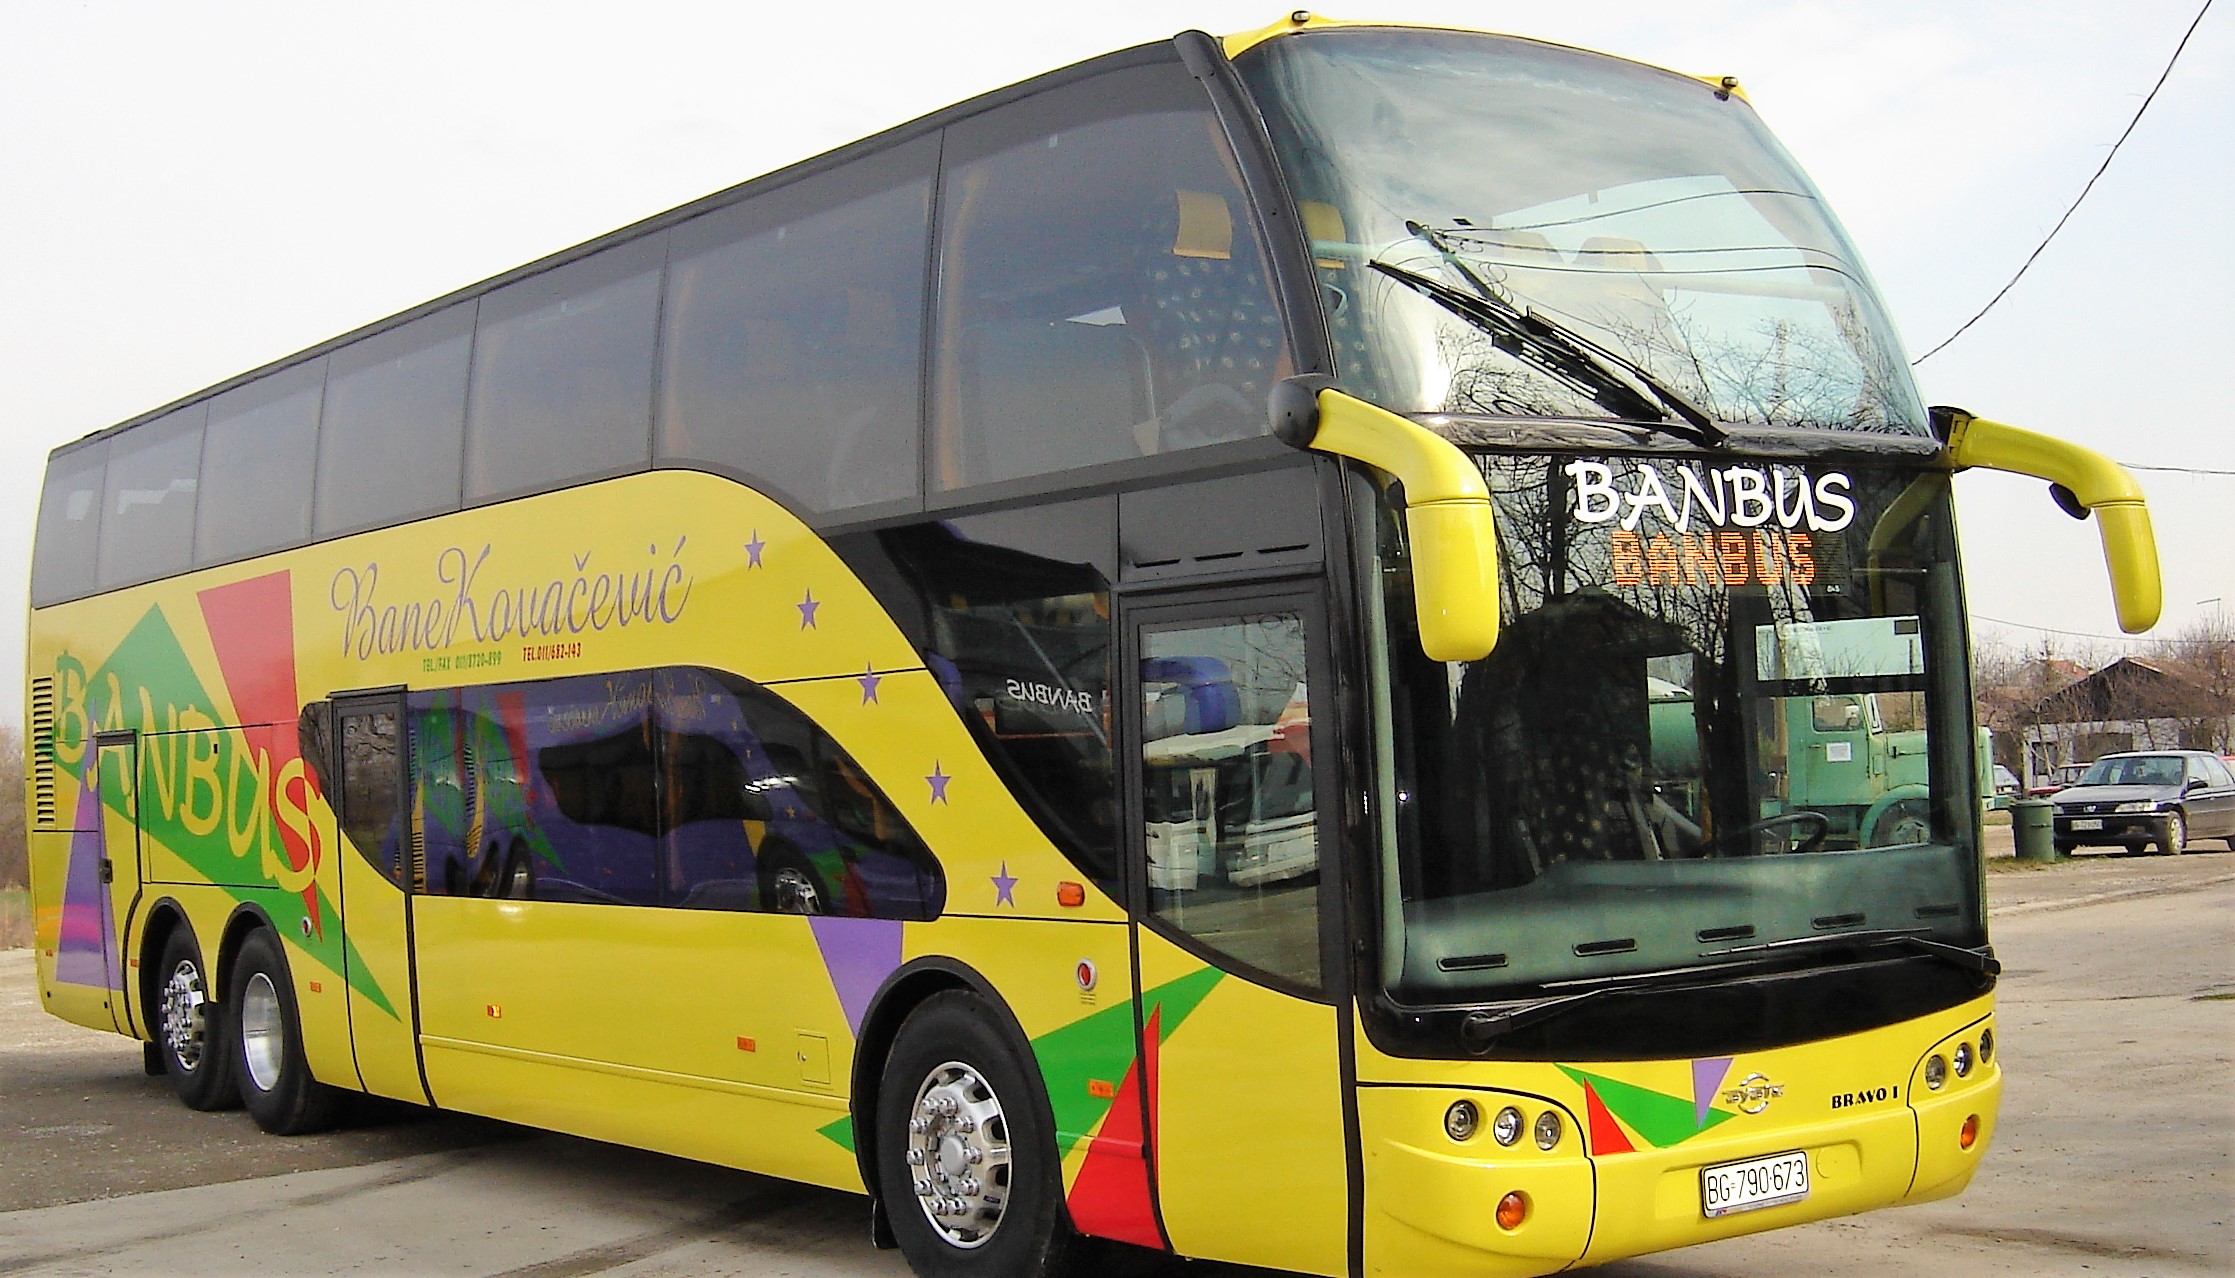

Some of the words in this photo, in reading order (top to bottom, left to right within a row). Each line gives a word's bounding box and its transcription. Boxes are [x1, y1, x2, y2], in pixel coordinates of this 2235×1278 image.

[1565, 459, 1855, 532] BANBUS
[1611, 530, 1817, 586] BANBUS
[55, 650, 323, 893] BANBUS
[1831, 1088, 1887, 1109] BRAVO
